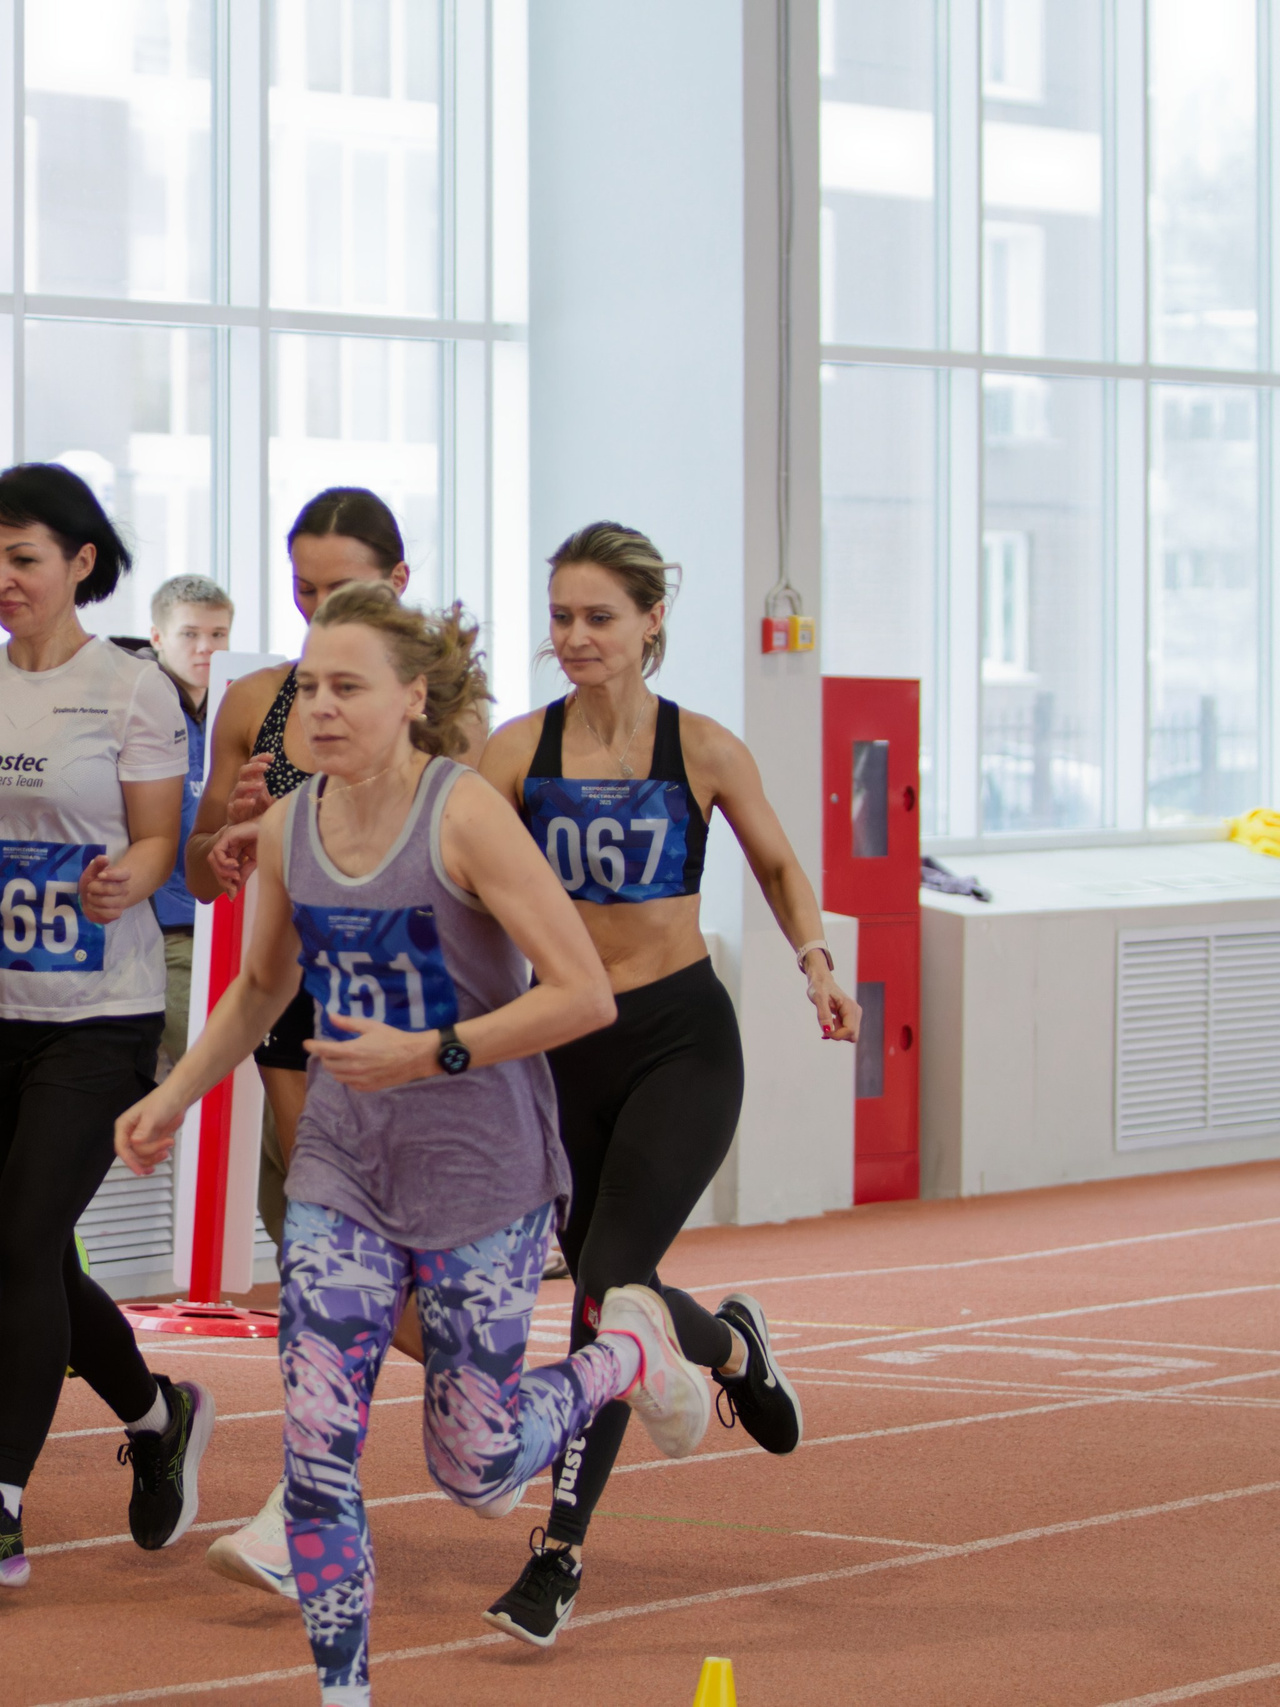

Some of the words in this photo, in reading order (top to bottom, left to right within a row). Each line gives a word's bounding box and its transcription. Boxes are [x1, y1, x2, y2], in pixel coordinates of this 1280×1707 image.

[15, 774, 44, 788] Team
[546, 816, 669, 893] 067
[315, 950, 427, 1029] 151
